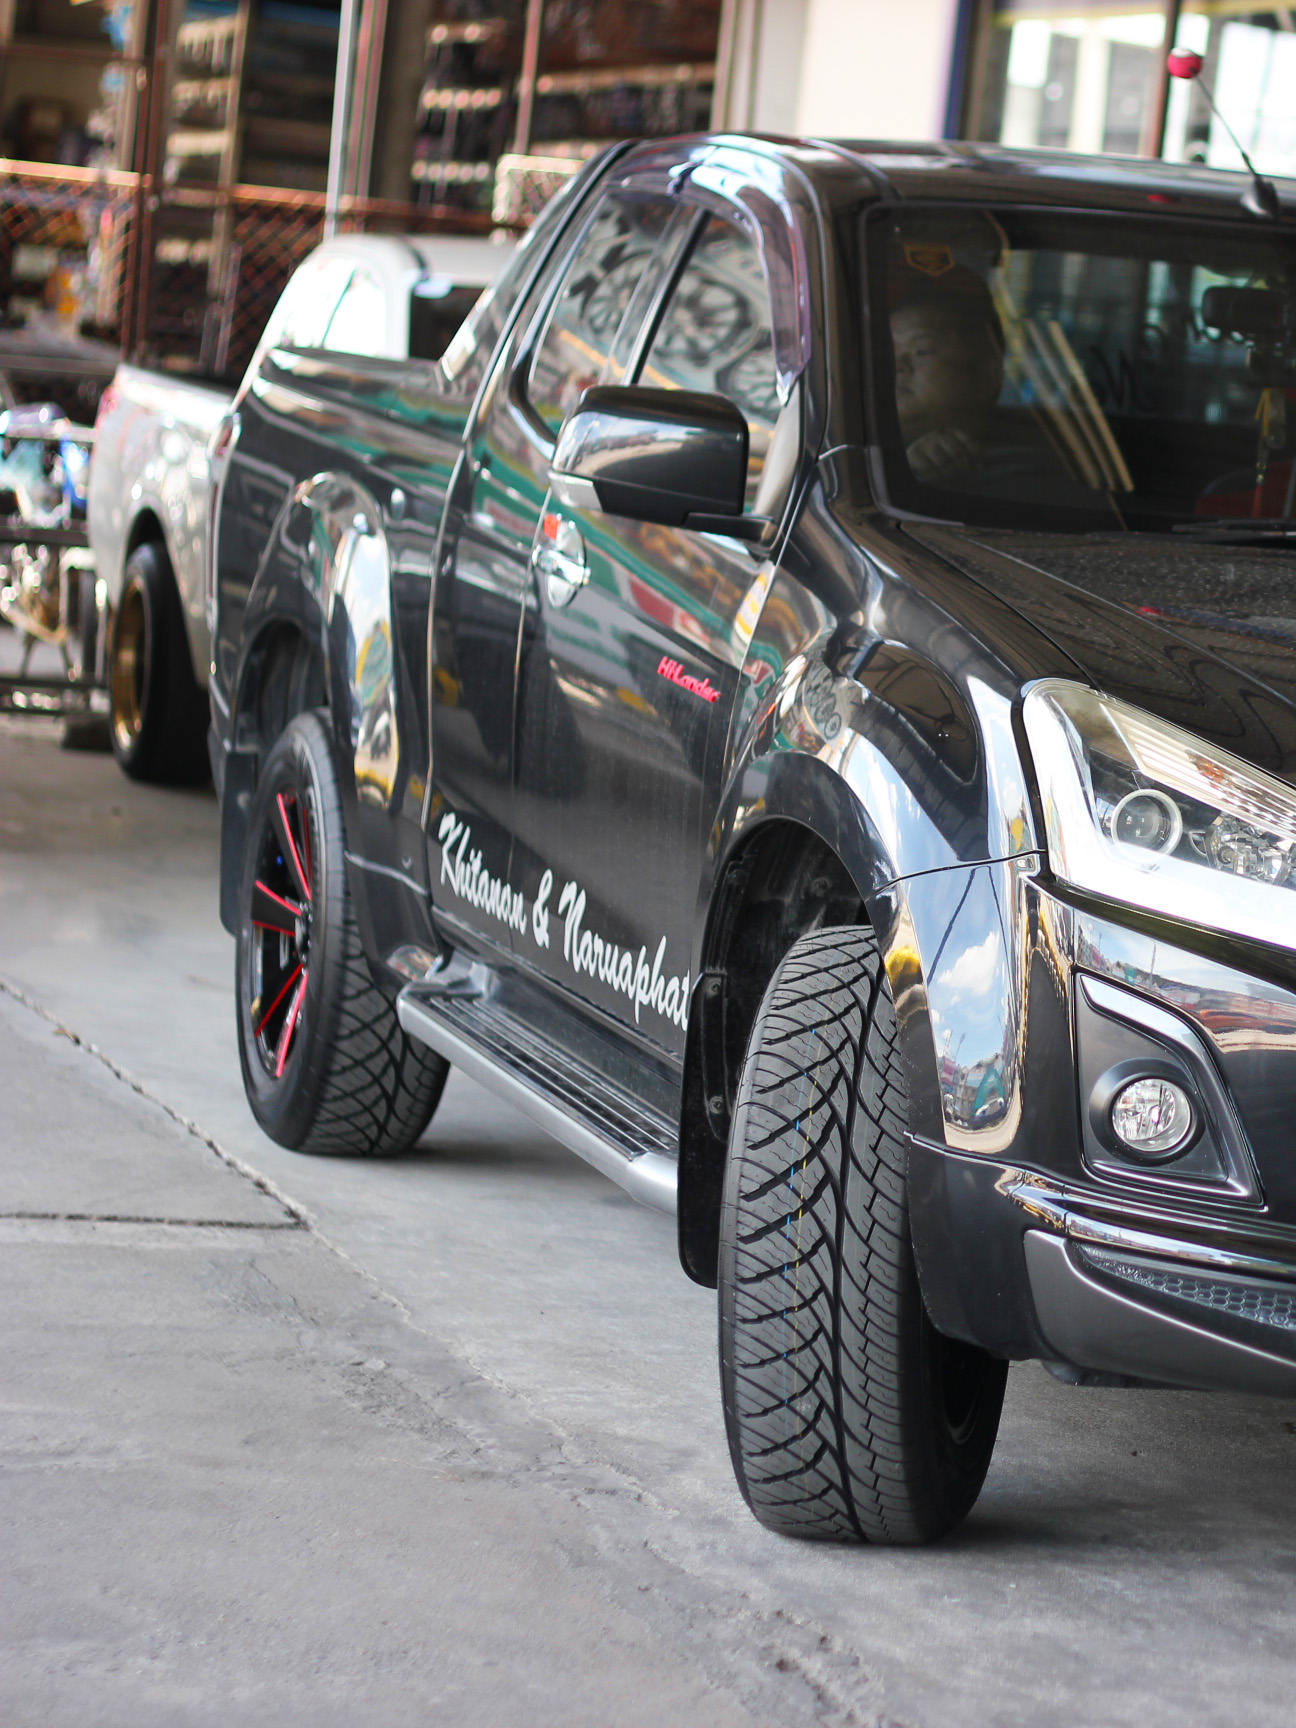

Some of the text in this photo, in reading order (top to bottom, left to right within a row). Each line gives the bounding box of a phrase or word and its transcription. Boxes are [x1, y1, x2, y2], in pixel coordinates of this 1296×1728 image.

[438, 812, 690, 1032] Khitanan & Naruaphat
